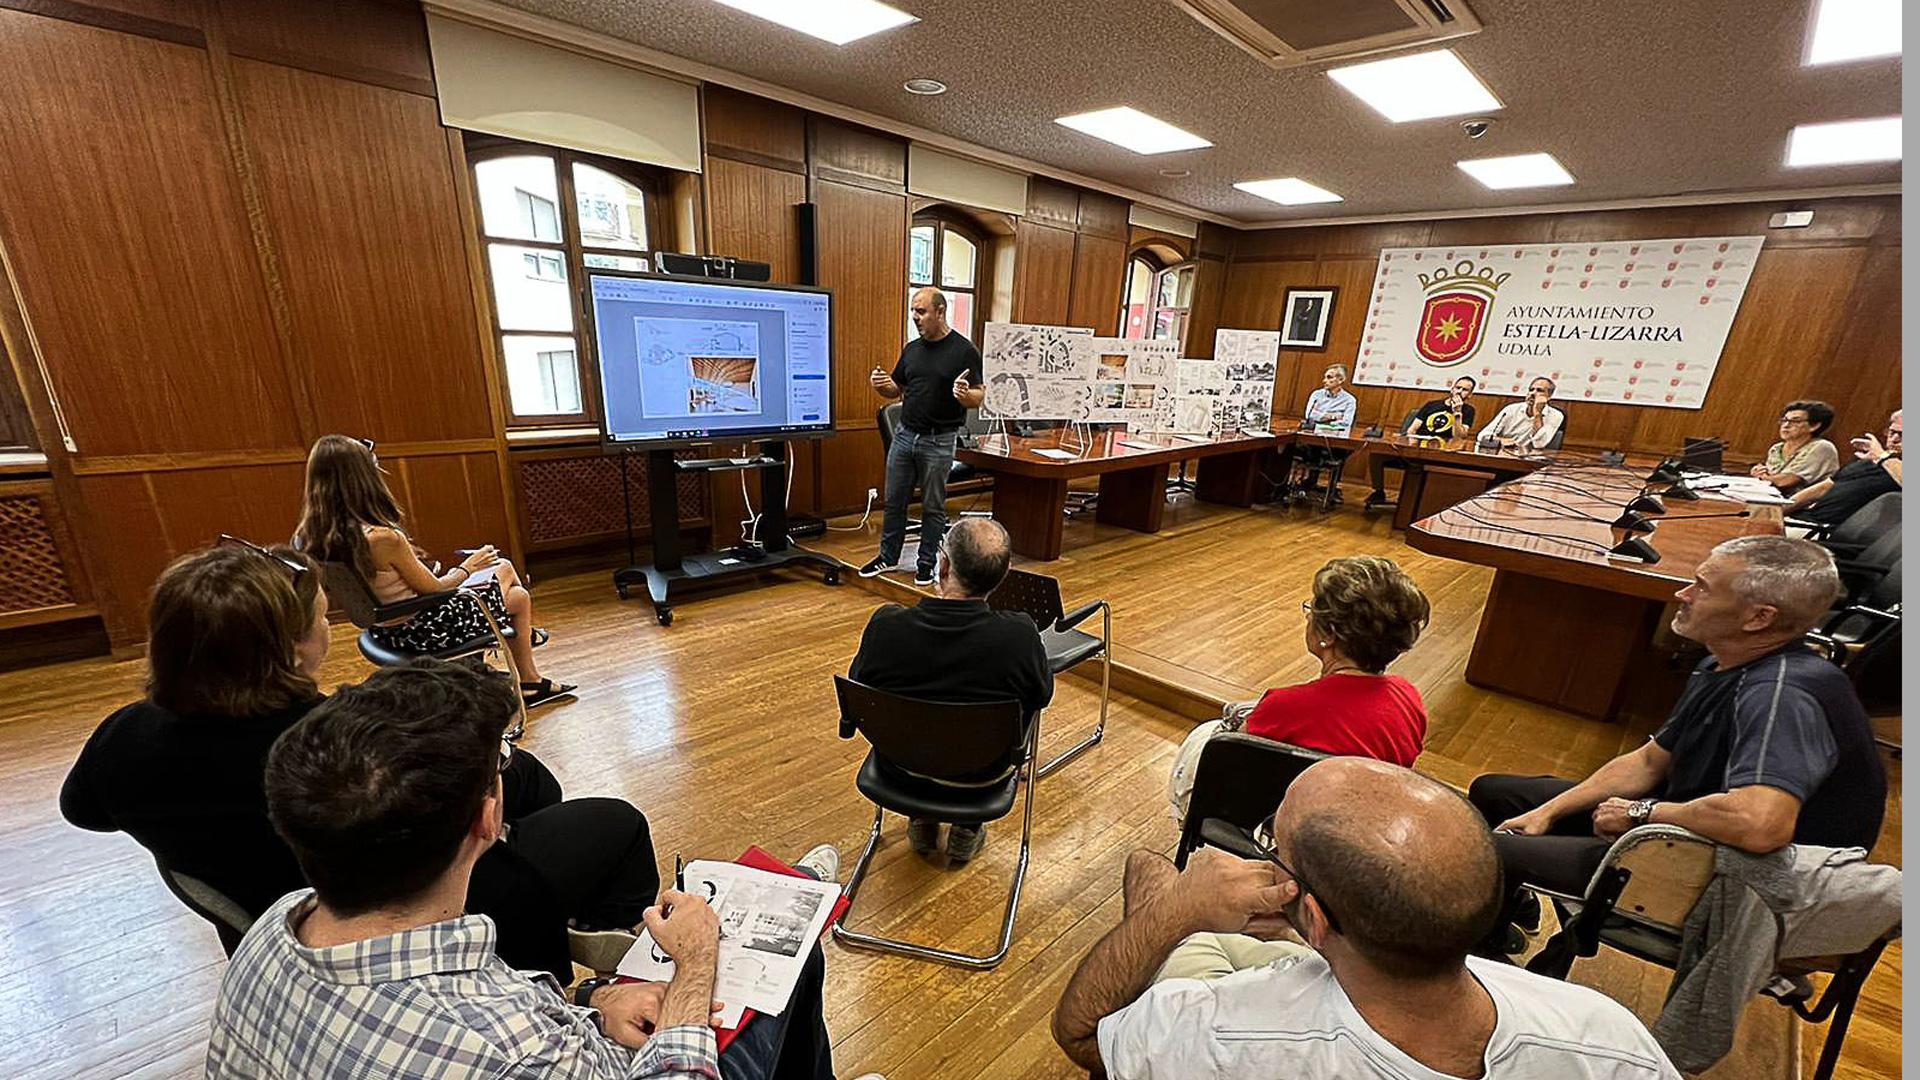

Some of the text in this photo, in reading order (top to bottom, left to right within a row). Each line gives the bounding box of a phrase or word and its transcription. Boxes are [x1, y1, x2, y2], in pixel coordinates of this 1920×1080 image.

[1506, 306, 1655, 320] AYUNTAMIENTO
[1503, 323, 1683, 342] ESTELLA-LIZARRA
[1498, 343, 1552, 356] UDALA
